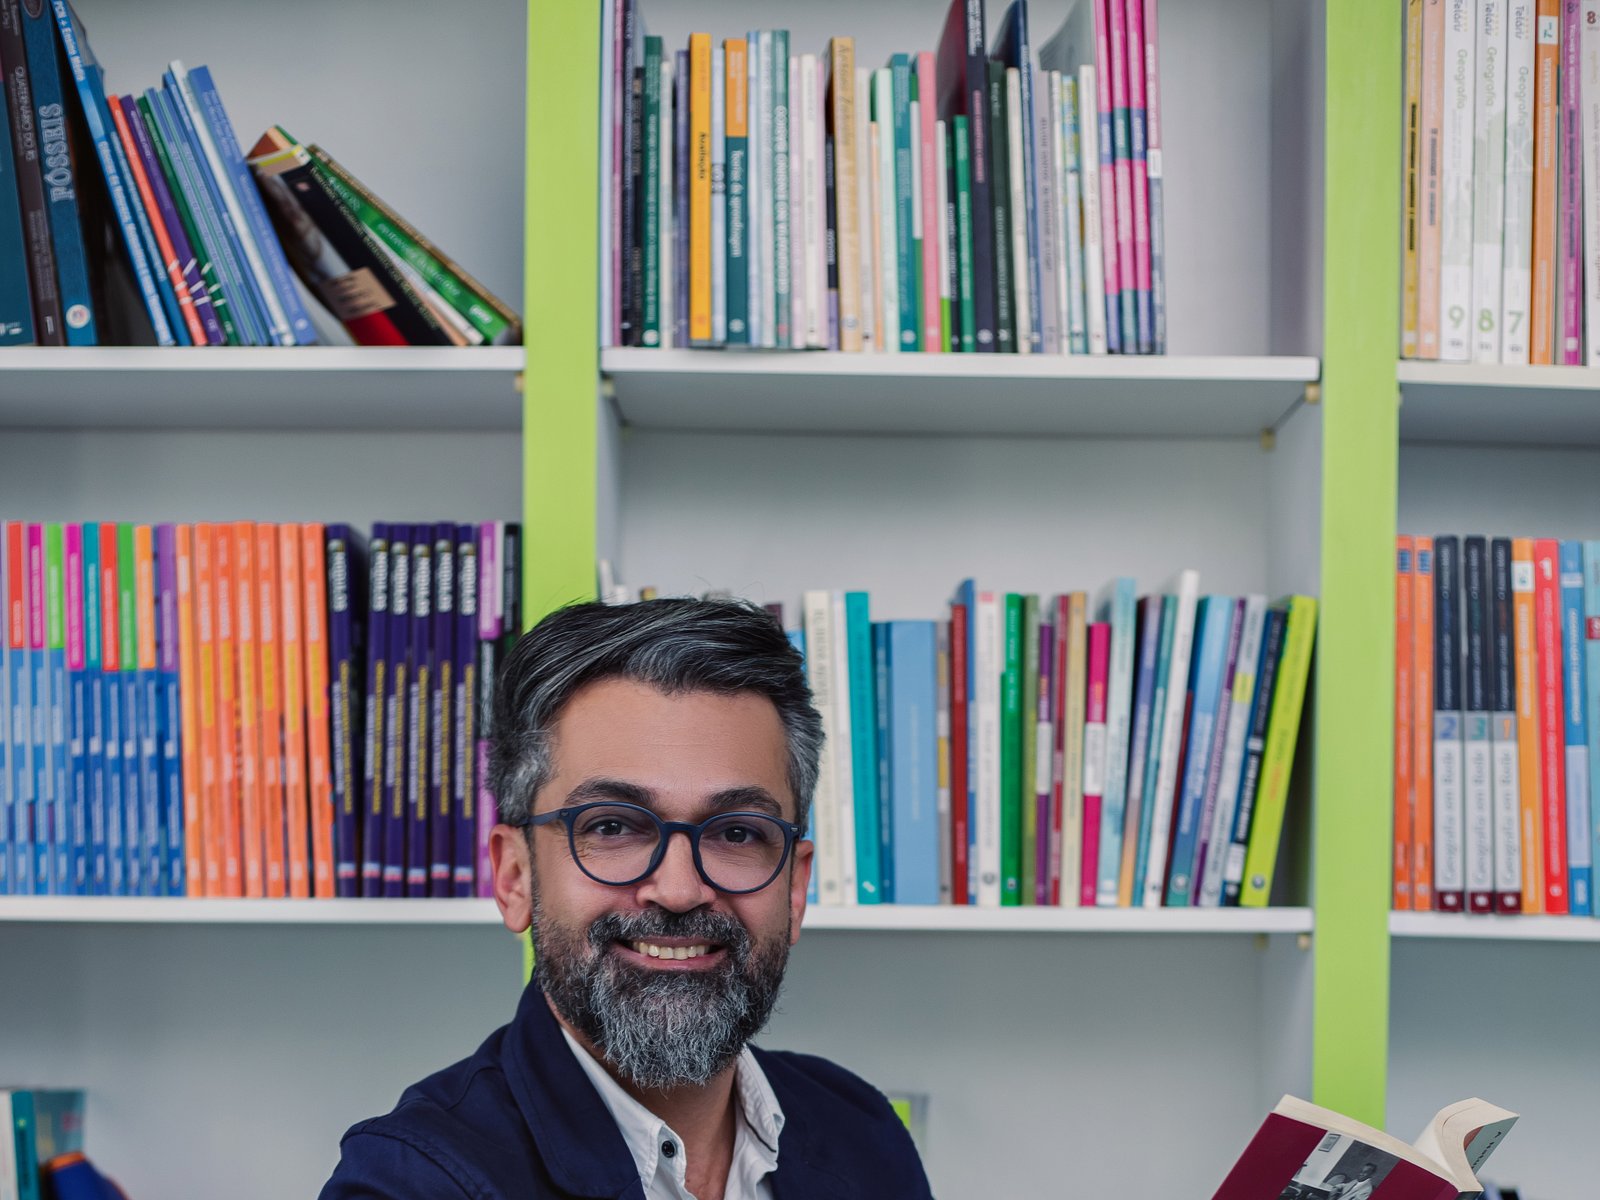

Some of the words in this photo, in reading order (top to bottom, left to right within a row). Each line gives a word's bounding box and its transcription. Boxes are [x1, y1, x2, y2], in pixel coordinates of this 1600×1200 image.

[1448, 306, 1465, 330] 9
[1478, 308, 1495, 333] 8
[1507, 311, 1525, 336] 7
